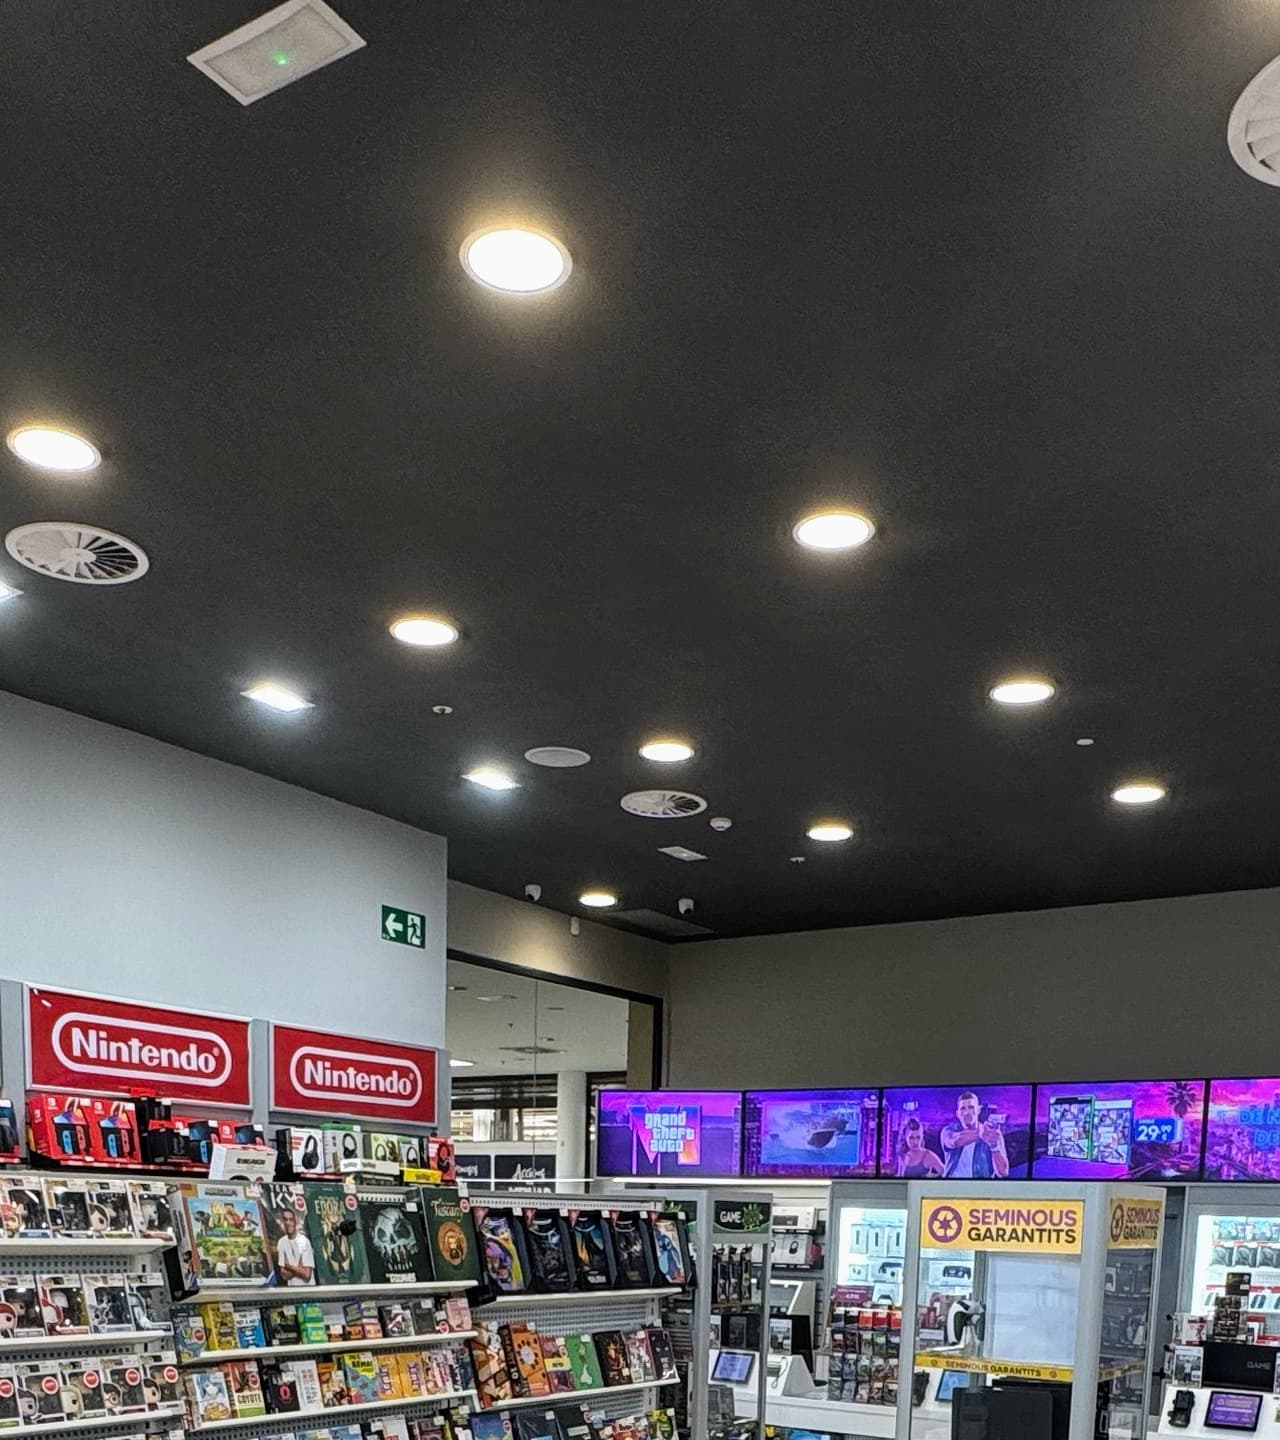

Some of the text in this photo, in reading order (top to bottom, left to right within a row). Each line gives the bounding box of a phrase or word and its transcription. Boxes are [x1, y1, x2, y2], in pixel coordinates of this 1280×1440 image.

[72, 1026, 217, 1074] Nintendo
[303, 1058, 415, 1097] Nintendo
[644, 1111, 686, 1128] grand
[652, 1126, 694, 1140] theft
[1254, 1130, 1280, 1146] DE
[650, 1139, 684, 1152] auto
[719, 1211, 742, 1224] GAME
[968, 1208, 1077, 1228] SEMINOUS
[1124, 1207, 1160, 1227] SEMINOUS
[967, 1226, 1077, 1245] GARANTITS
[1123, 1223, 1159, 1241] GARANTITS
[945, 1360, 1041, 1377] SEMINOUS GARANTITS
[237, 1392, 263, 1405] COYOTE
